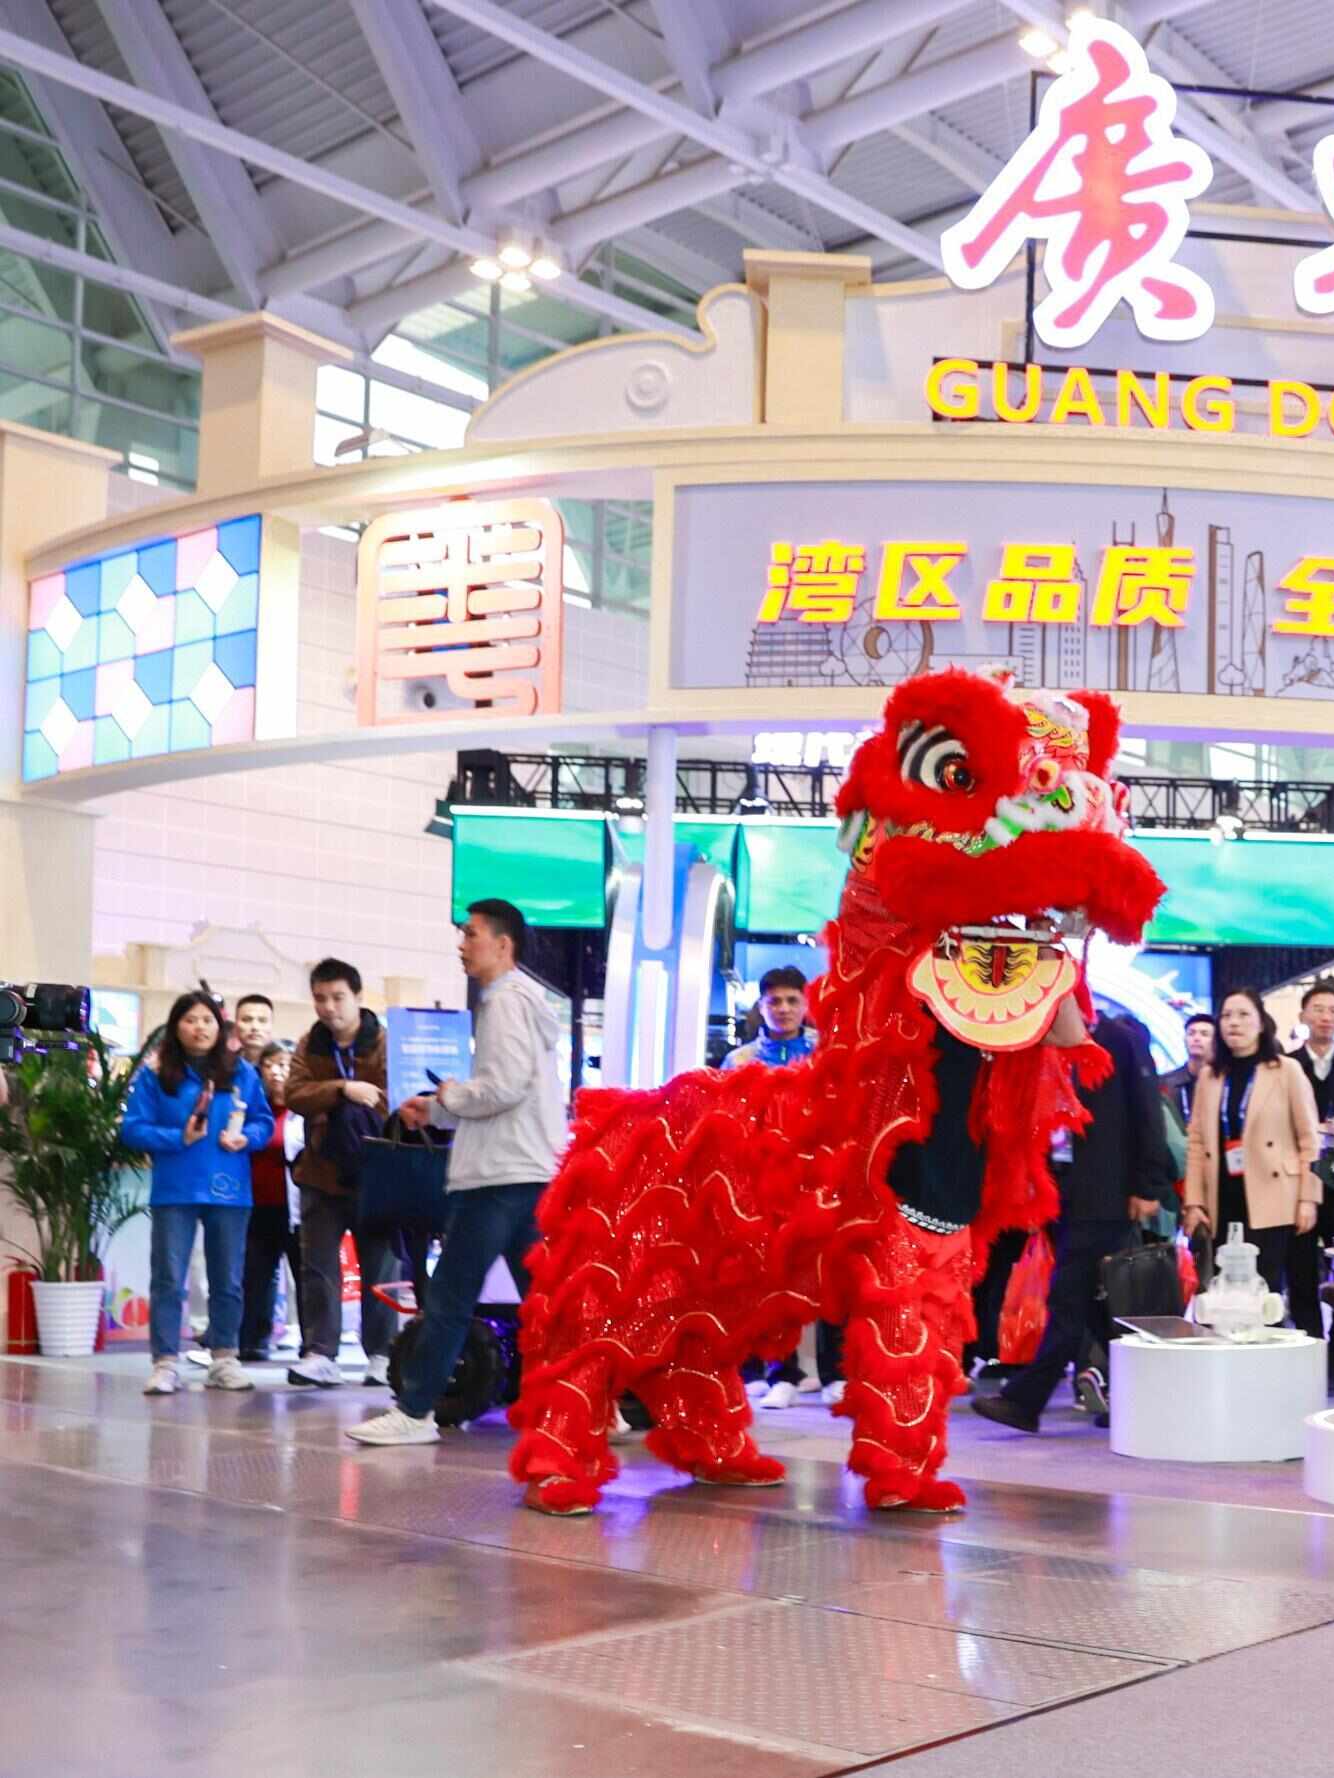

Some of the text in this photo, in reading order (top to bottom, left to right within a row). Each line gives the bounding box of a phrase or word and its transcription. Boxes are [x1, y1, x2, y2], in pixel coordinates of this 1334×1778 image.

[925, 358, 1235, 433] GUANG
[757, 539, 1196, 628] 湾区品质
